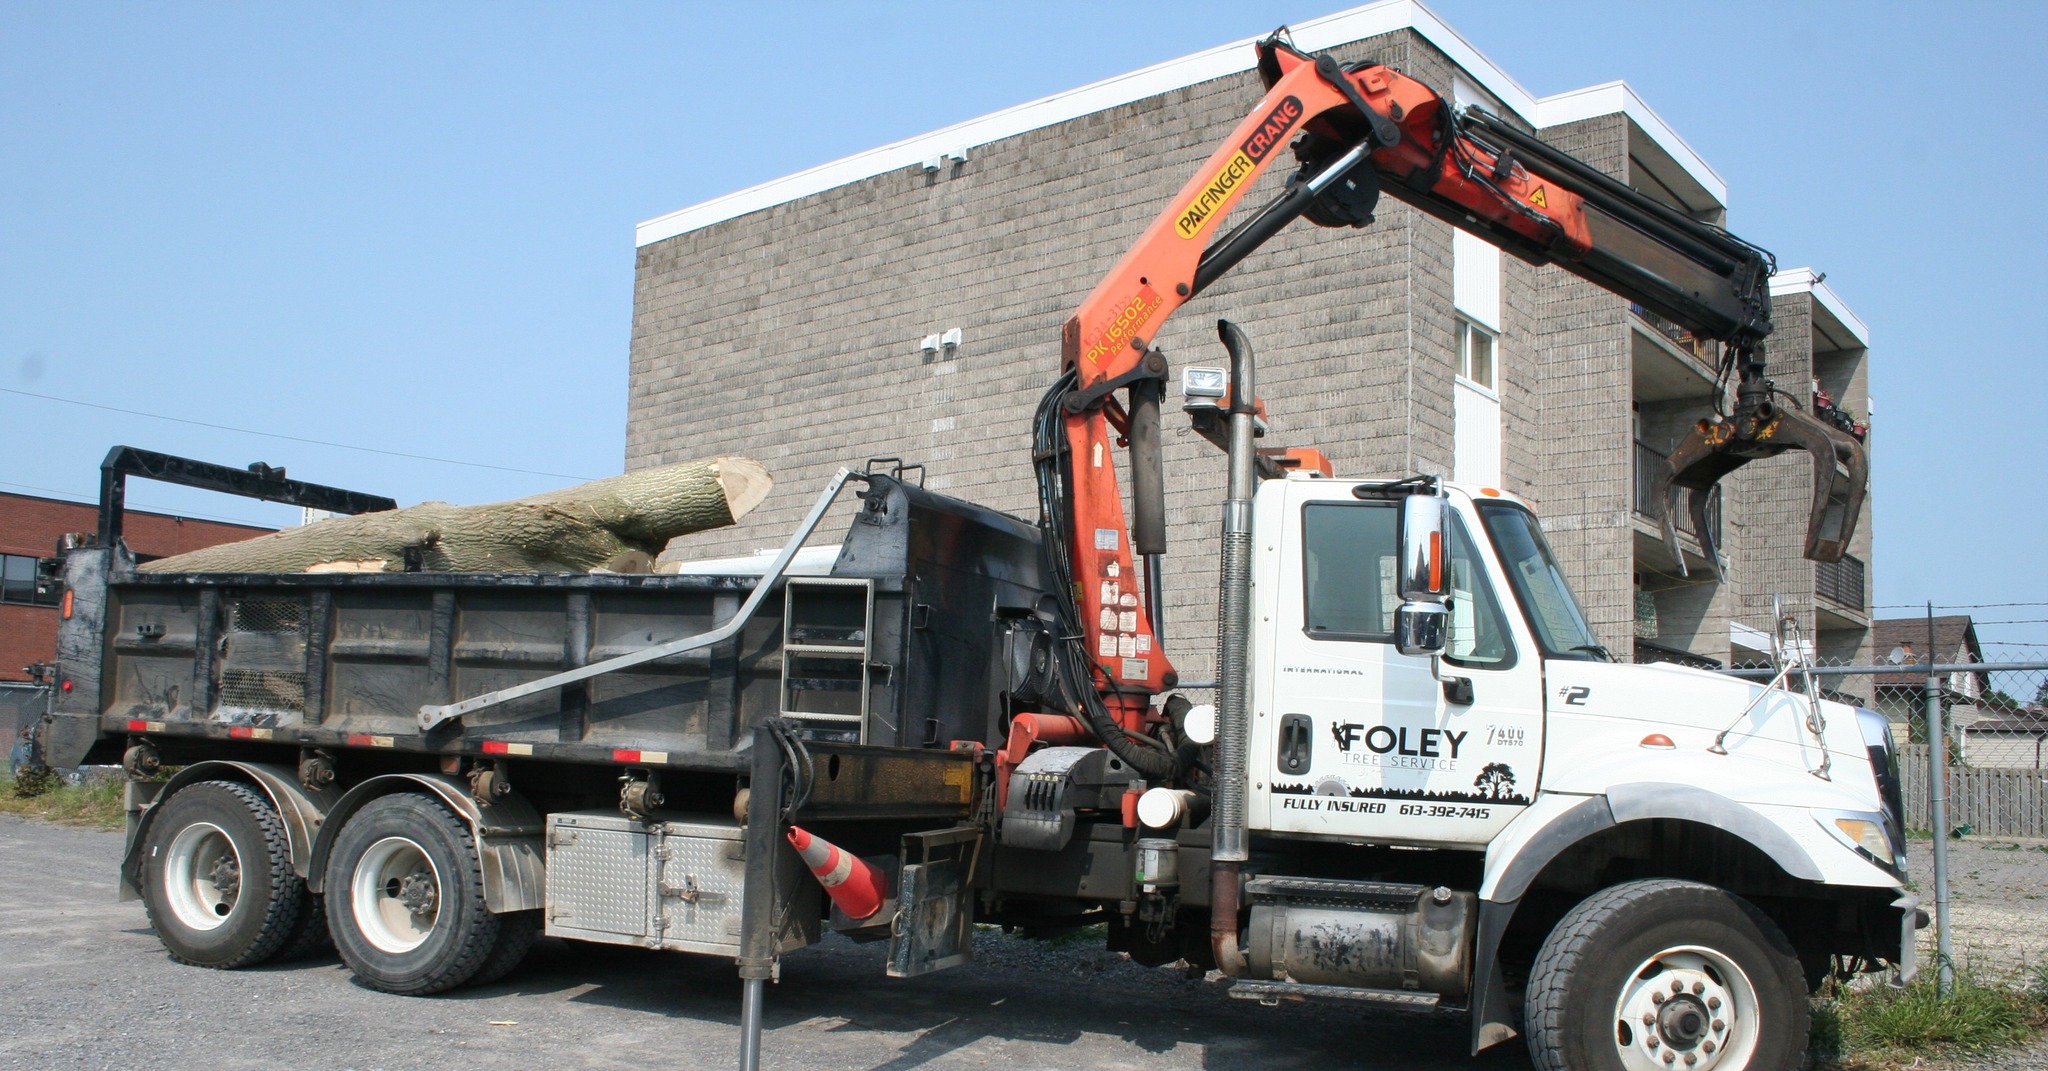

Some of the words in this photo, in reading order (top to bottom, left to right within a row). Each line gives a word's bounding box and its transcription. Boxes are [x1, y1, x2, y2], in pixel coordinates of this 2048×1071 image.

[1178, 155, 1251, 235] PALFINGER
[1246, 100, 1299, 158] CRANE
[1086, 339, 1109, 365] PK
[1104, 296, 1147, 343] 16502
[1110, 296, 1163, 356] Performance
[1283, 664, 1364, 676] INTERNATIONAL
[1558, 685, 1591, 706] #2
[1344, 723, 1469, 759] FOLEY
[1486, 725, 1524, 745] 7400
[1343, 752, 1380, 766] TREE
[1390, 755, 1457, 771] SERVICE
[1283, 798, 1323, 811] FULLY
[1326, 800, 1387, 814] INSURED
[1399, 804, 1491, 819] 613-392-7415
